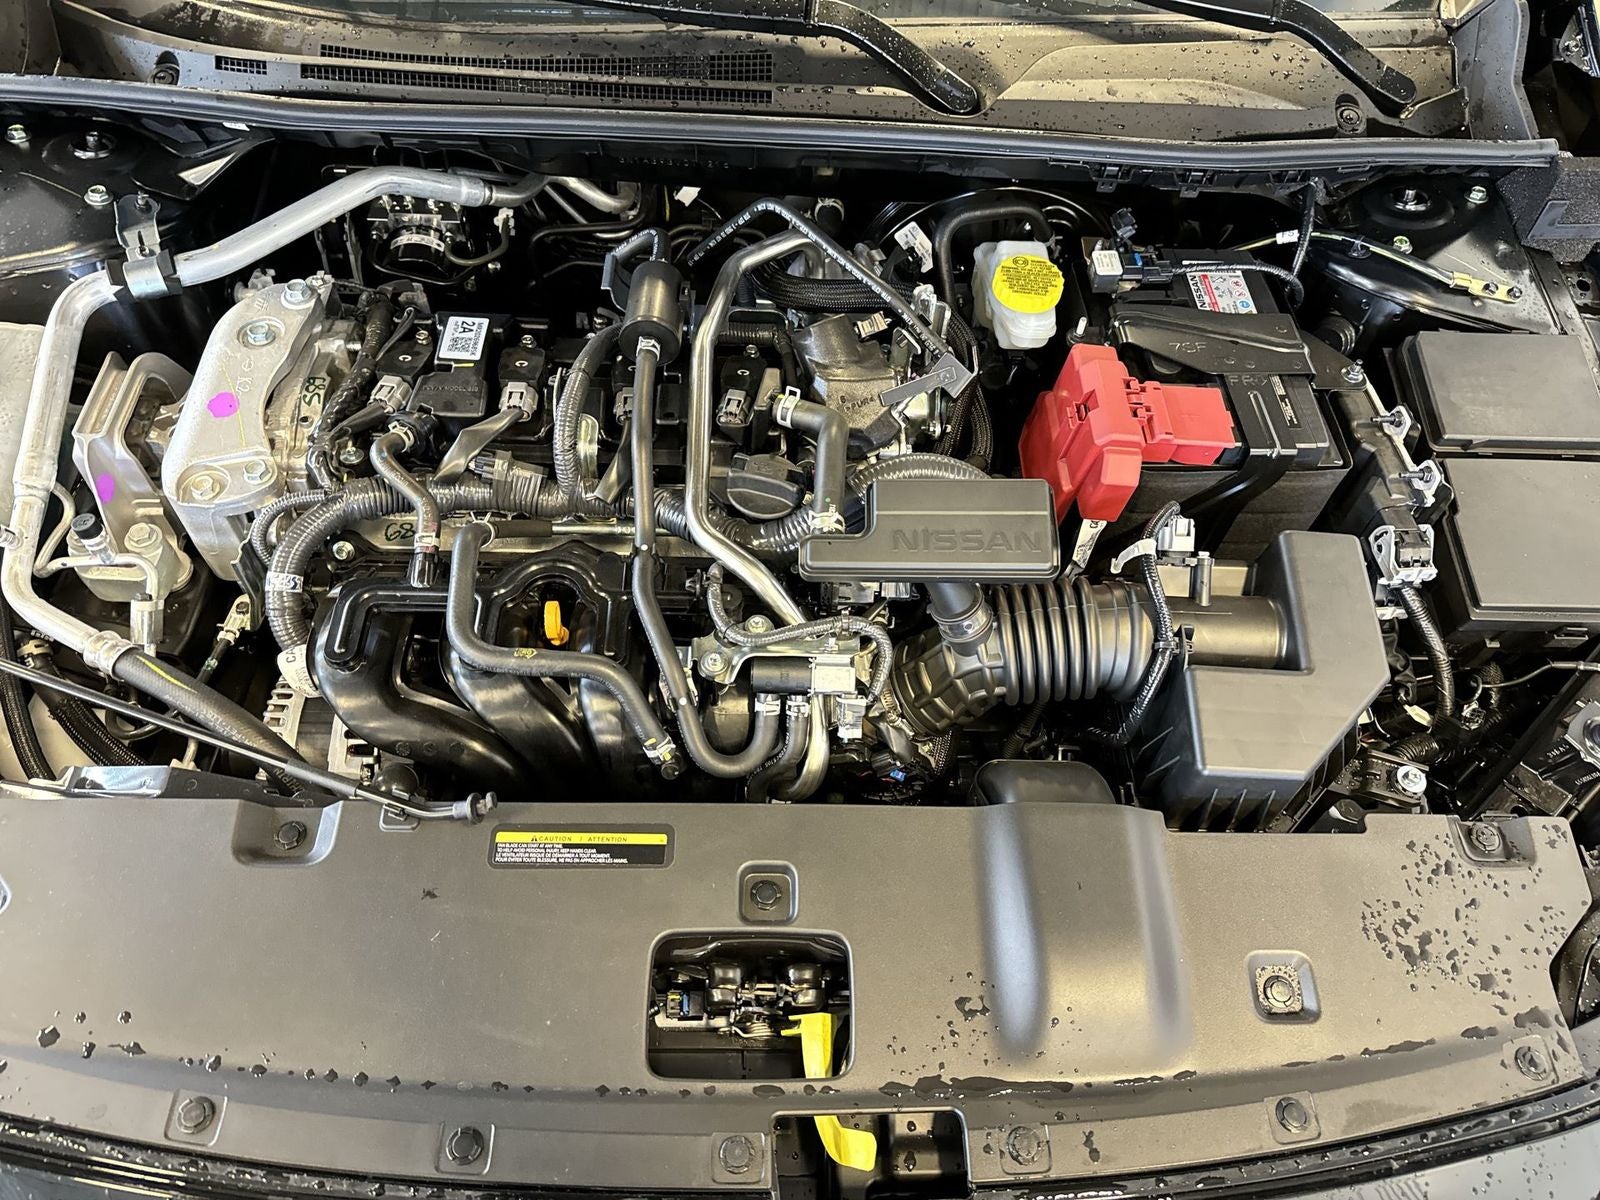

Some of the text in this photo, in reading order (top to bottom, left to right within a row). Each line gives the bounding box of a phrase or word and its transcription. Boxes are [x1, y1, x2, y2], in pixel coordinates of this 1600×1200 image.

[1189, 275, 1208, 309] NISSAN
[459, 320, 476, 334] 2A
[891, 529, 1043, 552] NISSAN
